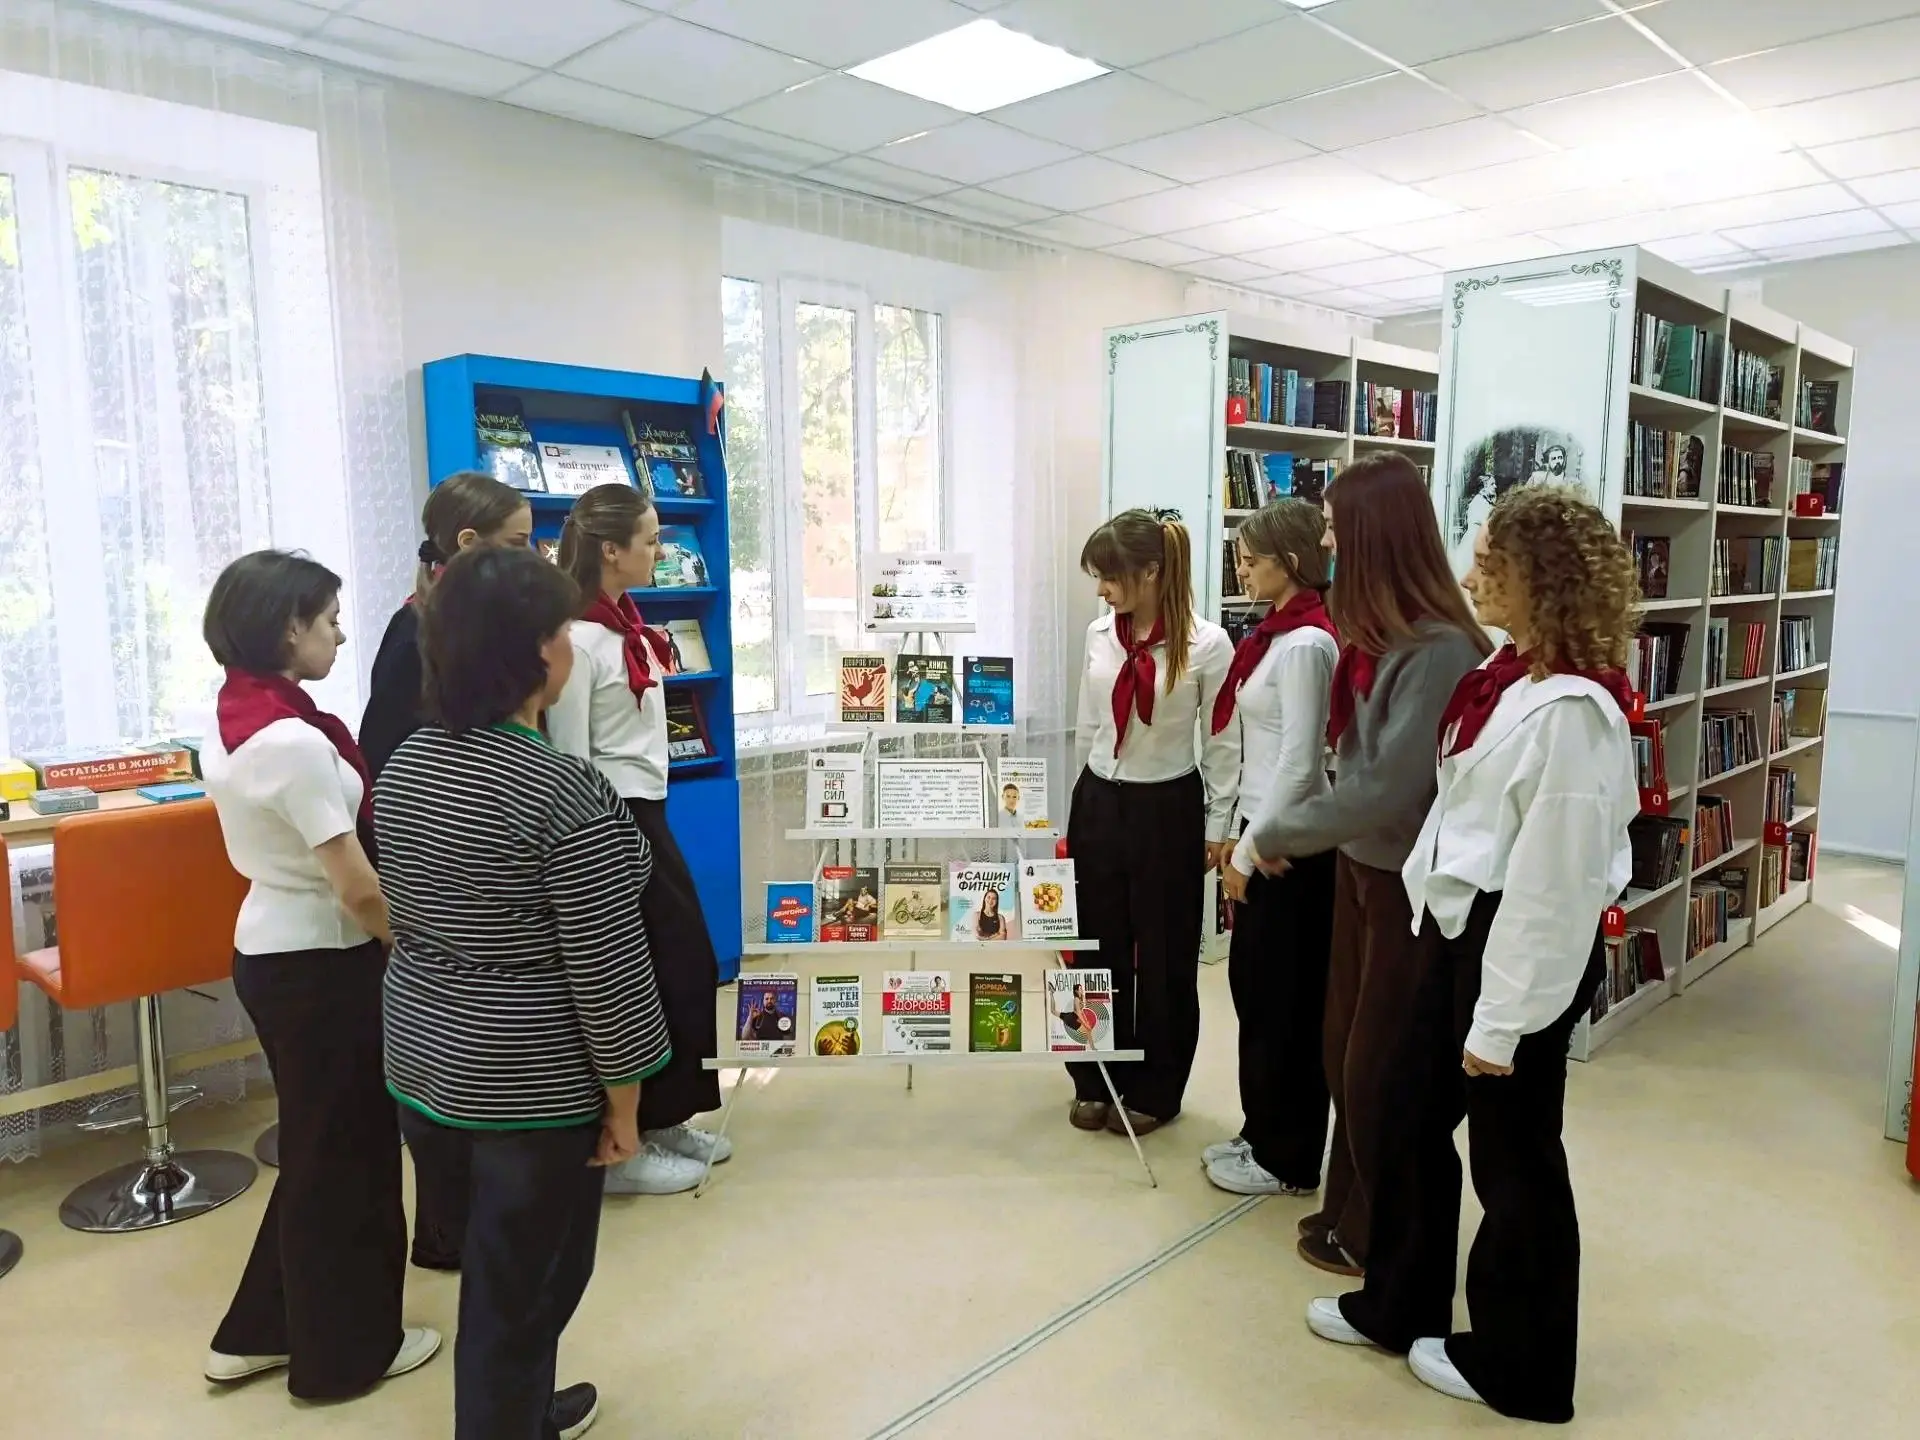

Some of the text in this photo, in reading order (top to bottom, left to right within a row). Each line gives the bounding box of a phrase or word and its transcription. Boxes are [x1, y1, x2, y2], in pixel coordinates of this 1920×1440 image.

[50, 754, 178, 779] ОСТАТЬСЯ В ЖИВЫХ
[824, 780, 844, 789] НЕТ
[824, 790, 845, 801] СИЛ
[957, 871, 1011, 881] #САШИН
[959, 881, 1006, 892] ФИТНЕС
[1607, 911, 1618, 925] П
[1053, 973, 1110, 992] ХВАТИТ НЫТЬ!
[840, 991, 859, 1001] ГЕН
[895, 992, 943, 1001] ЖЕНСКОЕ
[822, 1001, 859, 1009] ЗДОРОВЬЯ
[891, 1000, 946, 1011] ЗДОРОВЬЕ
